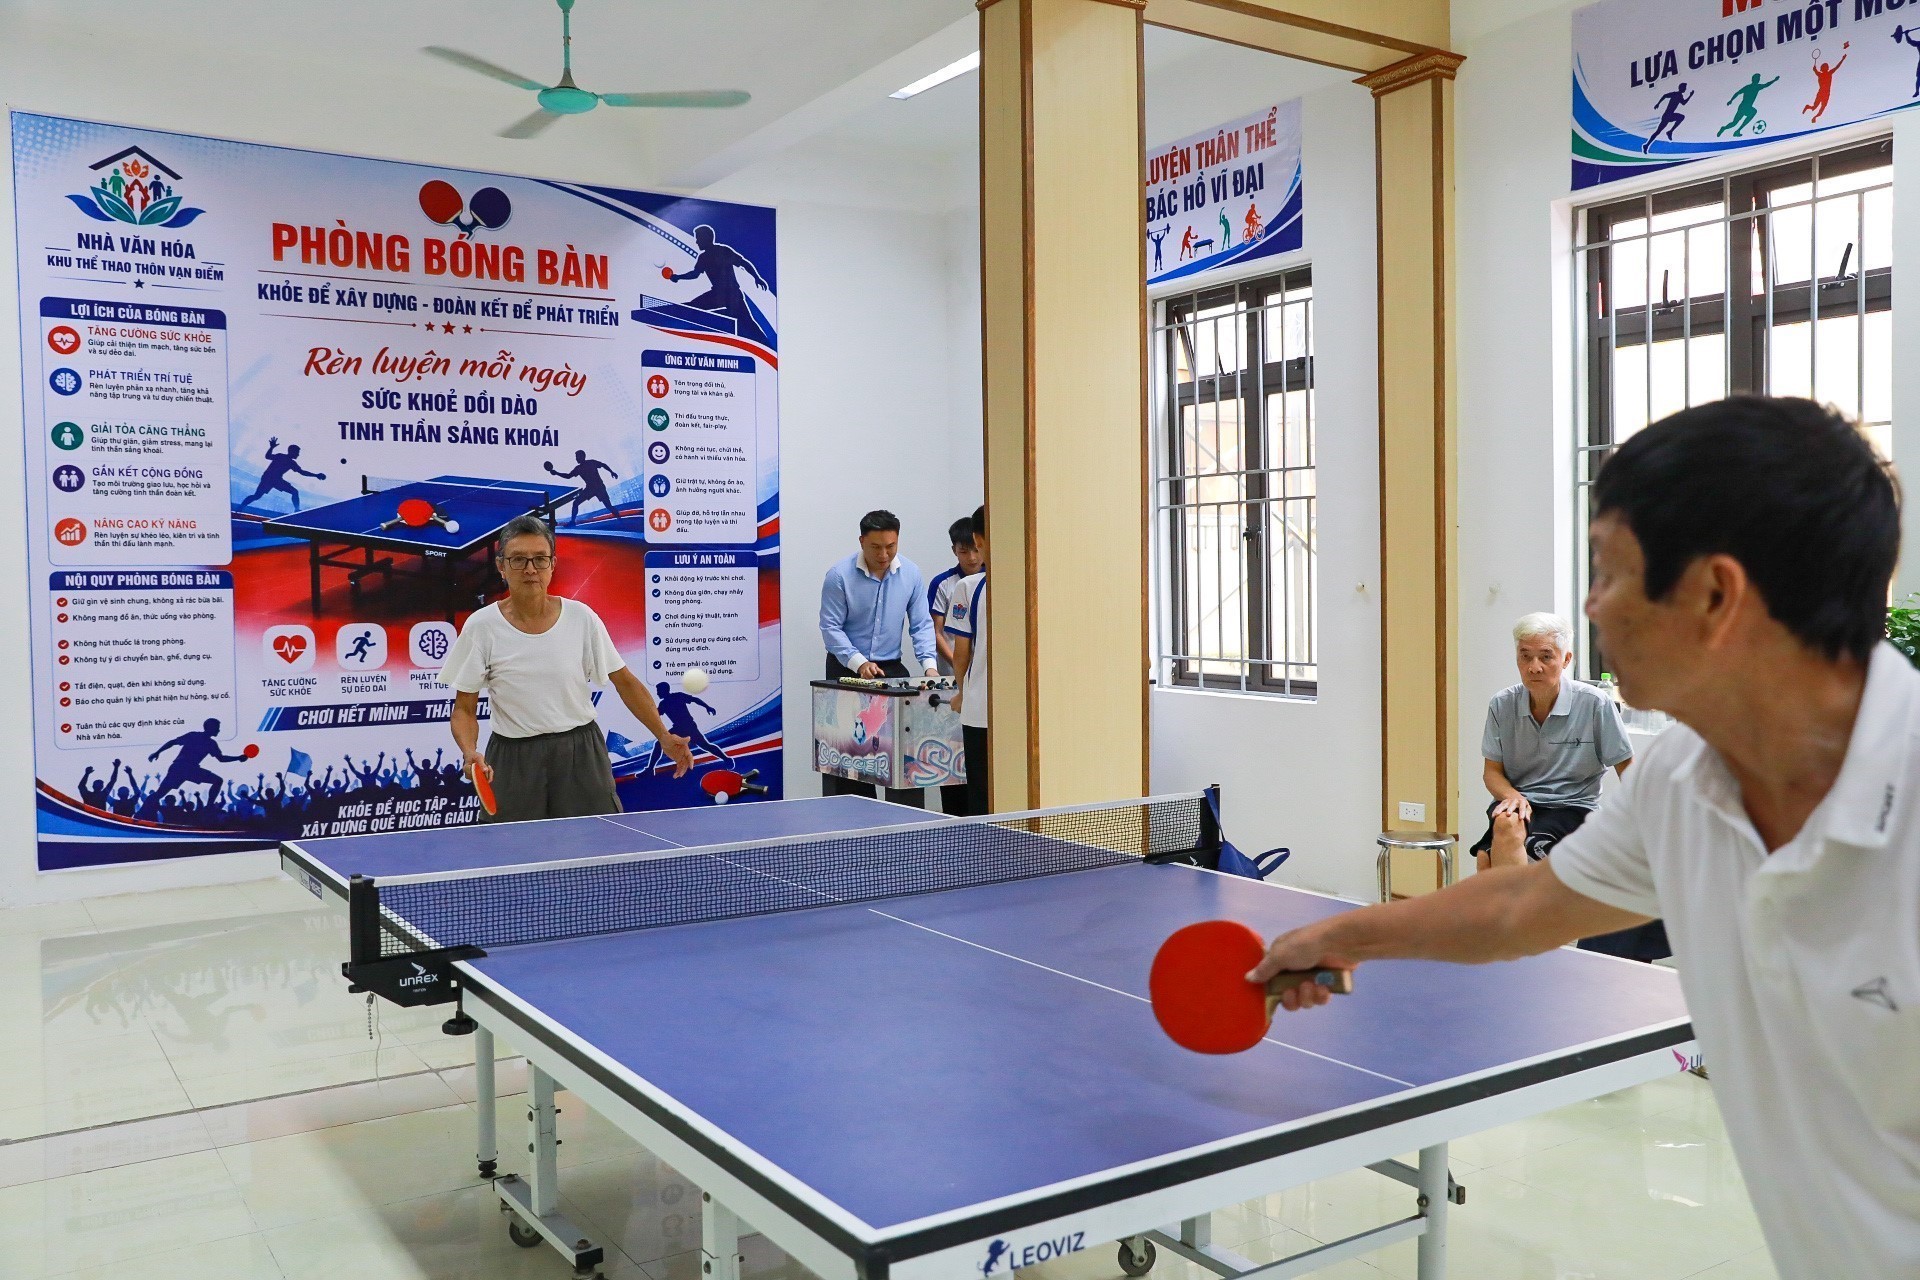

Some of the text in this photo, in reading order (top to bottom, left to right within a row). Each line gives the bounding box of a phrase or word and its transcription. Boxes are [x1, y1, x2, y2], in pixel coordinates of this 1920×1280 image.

[1630, 49, 1678, 89] LỰA
[1688, 21, 1765, 70] CHỌN
[1777, 0, 1842, 45] MỘT
[1146, 106, 1278, 186] UYỆN THÂN THỂ
[1146, 162, 1264, 223] BÁC HỒ VĨ ĐẠI
[78, 232, 195, 259] NHÀ VĂN HÓA
[272, 220, 608, 290] PHÒNG BÓNG BÀN
[47, 254, 223, 281] KHU THỂ THAO THÔN VẠN ĐIỂM
[71, 303, 205, 324] LỢI ÍCH CỦA BÓNG BÀN
[258, 280, 302, 302] KHỎE
[309, 282, 331, 304] ĐỂ
[336, 287, 367, 307] XÂY
[373, 292, 417, 313] DỰNG
[433, 296, 476, 316] ĐOÀN
[481, 298, 508, 318] KẾT
[513, 299, 532, 320] ĐỂ
[537, 304, 574, 323] PHÁT
[578, 305, 619, 326] TRIỂN
[88, 326, 212, 342] TĂNG CƯỜNG SỨC KHỎE
[304, 347, 587, 396] Rèn luyện mỗi ngày
[665, 354, 739, 369] ỨNG XỬ VĂN MINH
[90, 368, 192, 384] PHÁT TRIỂN TRÍ TUỆ
[362, 387, 401, 410] SỨC
[464, 389, 495, 414] DỒI
[501, 394, 538, 416] DÀO
[91, 422, 205, 437] GIẢI TỎA CĂNG THẲNG
[338, 418, 559, 447] TINH THẦN SẢNG KHOÁI
[92, 464, 115, 476] GẮN
[118, 465, 138, 477] KẾT
[142, 467, 170, 479] CỘNG
[94, 518, 196, 528] NÂNG CAO KỸ NĂNG
[675, 553, 736, 565] LƯU Ý AN TOÀN
[65, 572, 220, 588] NỘI QUY PHÒNG BÓNG BÀN
[262, 677, 317, 687] TĂNG CƯỜNG
[411, 672, 431, 680] PHÁT
[419, 681, 432, 689] TRÍ
[270, 686, 312, 696] SỨC KHỎE
[342, 685, 352, 694] SỰ
[297, 708, 335, 726] CHƠI
[337, 703, 366, 723] HẾT
[368, 703, 409, 722] MÌNH
[818, 741, 890, 779] SOCCER
[338, 800, 373, 818] KHỎE
[376, 797, 394, 815] ĐỂ
[395, 800, 421, 816] HỌC
[425, 796, 448, 814] TẬP
[301, 821, 328, 837] XÂY
[331, 819, 367, 837] DỰNG
[371, 814, 396, 832] QUÊ
[398, 812, 441, 828] HƯƠNG
[445, 809, 473, 824] GIÀU
[1010, 1232, 1085, 1269] LEOVIZ
